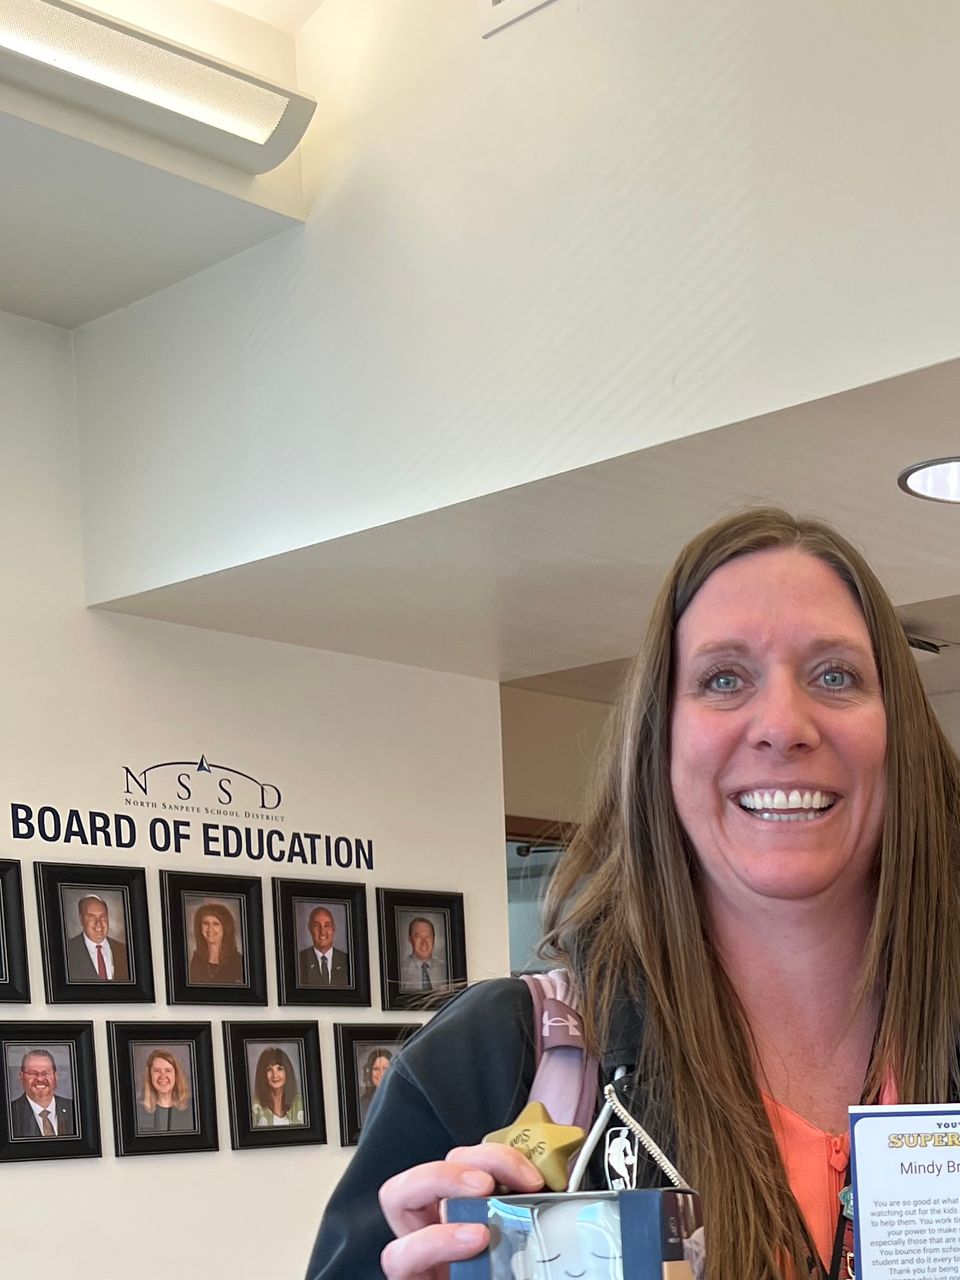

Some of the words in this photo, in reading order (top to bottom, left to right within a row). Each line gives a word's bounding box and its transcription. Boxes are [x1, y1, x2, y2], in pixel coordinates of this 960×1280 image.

[125, 798, 158, 809] NORTH
[162, 802, 201, 814] SANPETE
[204, 806, 240, 818] SCHOOL
[244, 811, 286, 823] DISTRICT
[10, 802, 138, 849] BOARD
[149, 817, 191, 854] OF
[202, 822, 374, 870] EDUCATION
[900, 1161, 942, 1177] Mindy
[912, 1199, 931, 1207] good
[870, 1238, 905, 1247] especially
